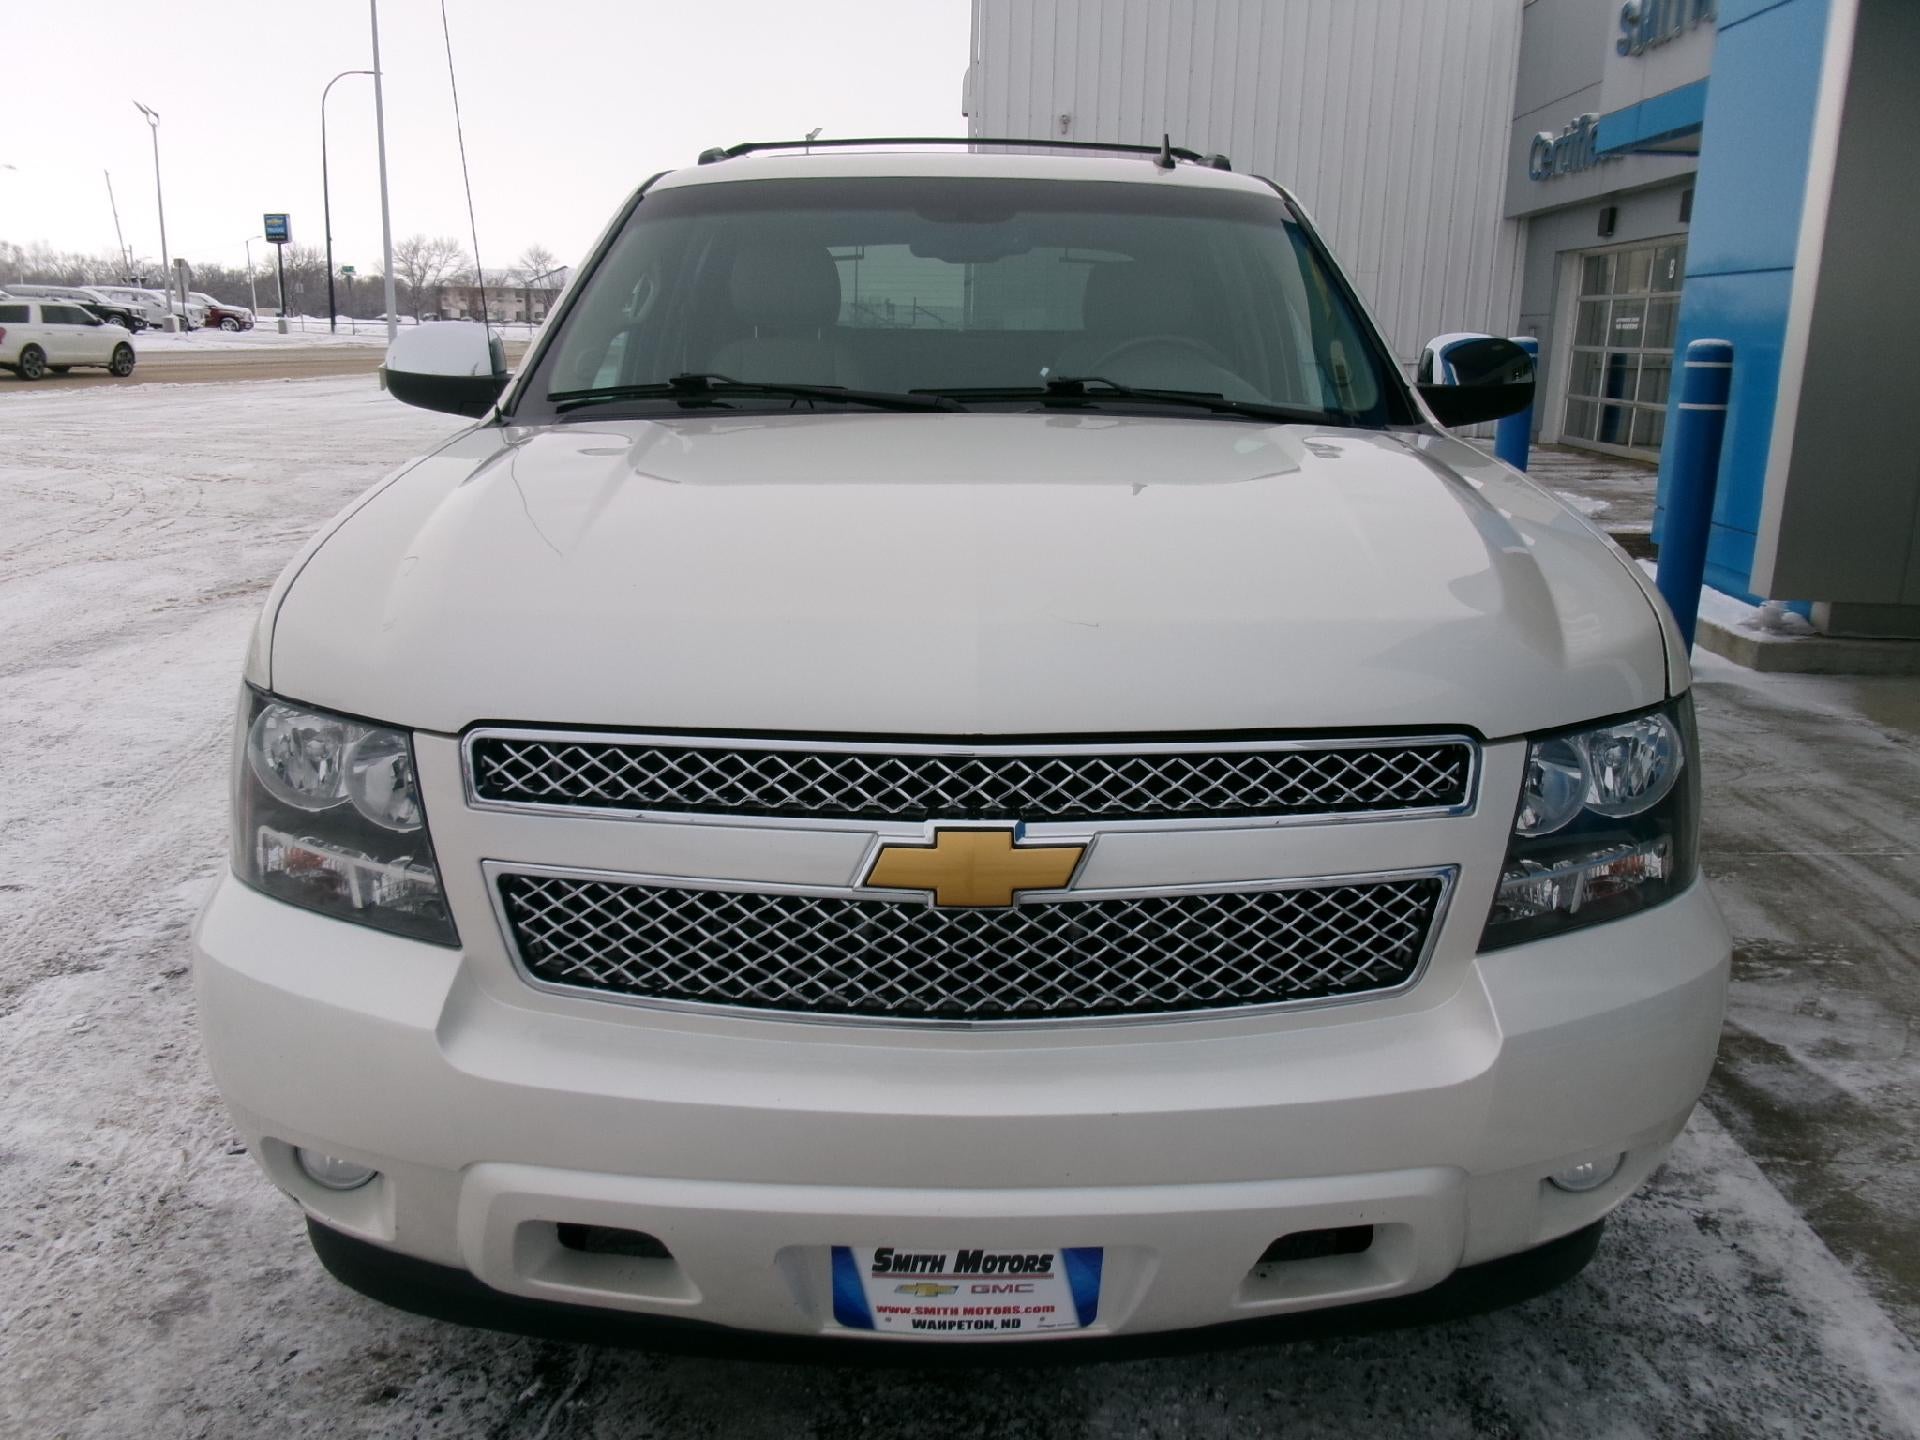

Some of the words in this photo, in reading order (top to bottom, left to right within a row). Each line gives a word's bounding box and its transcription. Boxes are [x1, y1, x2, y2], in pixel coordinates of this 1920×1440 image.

[871, 1247, 947, 1274] SMITH
[953, 1249, 1054, 1275] MOTORS
[970, 1283, 1035, 1295] GMC
[1001, 1318, 1022, 1330] ND
